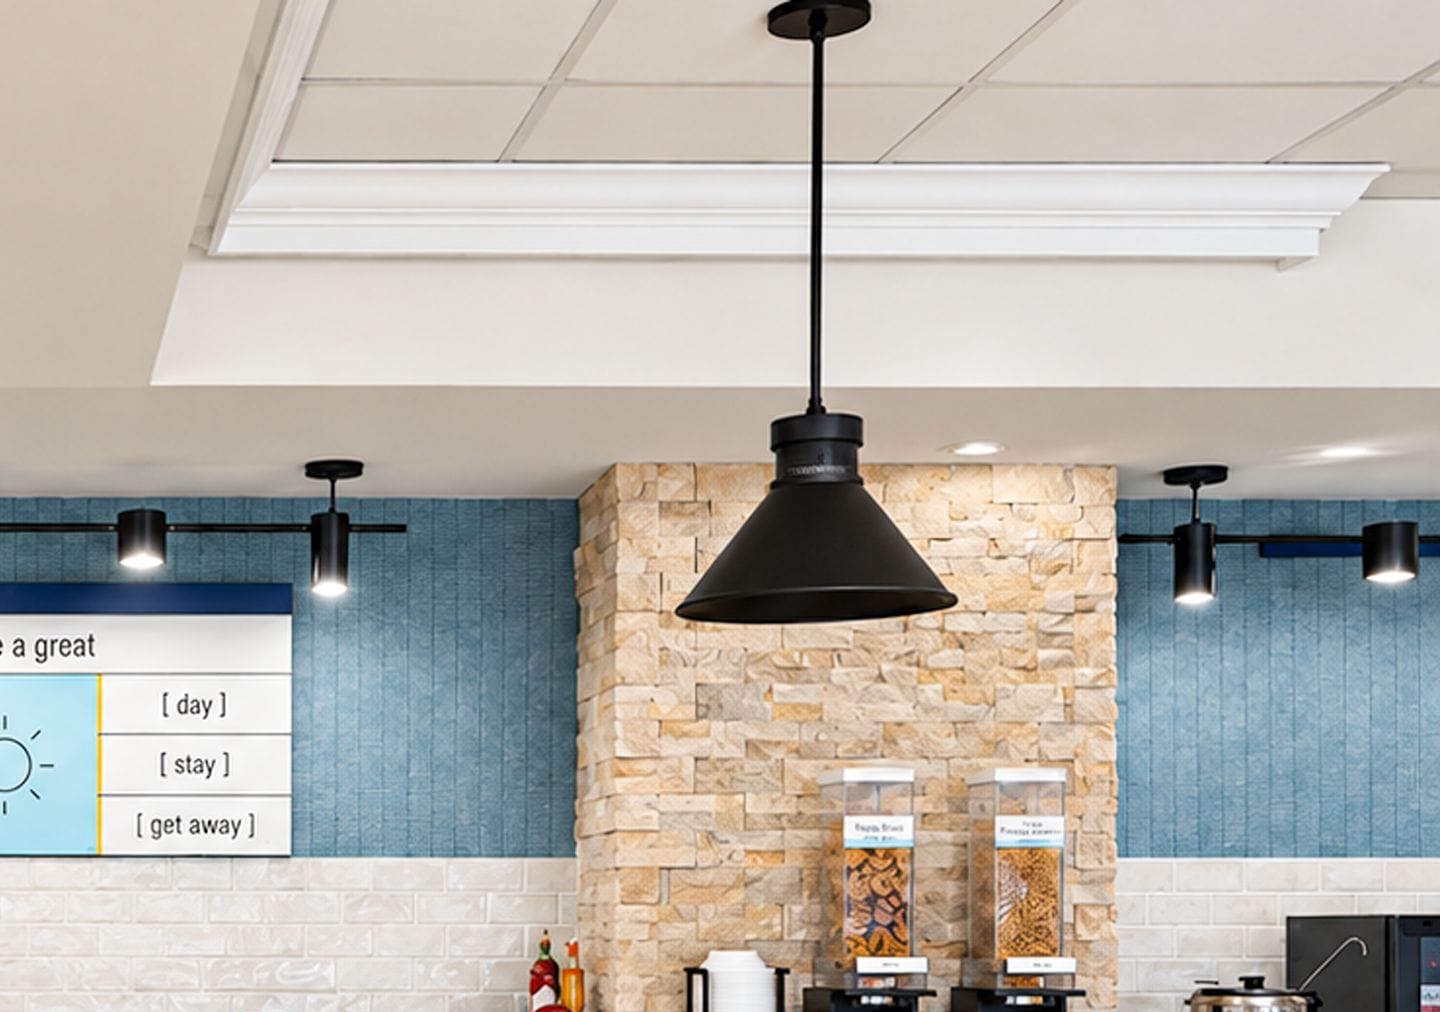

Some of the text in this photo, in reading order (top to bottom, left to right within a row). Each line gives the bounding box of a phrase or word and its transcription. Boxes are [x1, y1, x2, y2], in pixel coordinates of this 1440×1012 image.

[12, 637, 26, 658] a
[34, 633, 95, 664] great
[177, 693, 213, 720] day
[174, 755, 216, 780] stay
[150, 815, 182, 840] get
[189, 818, 242, 840] away
